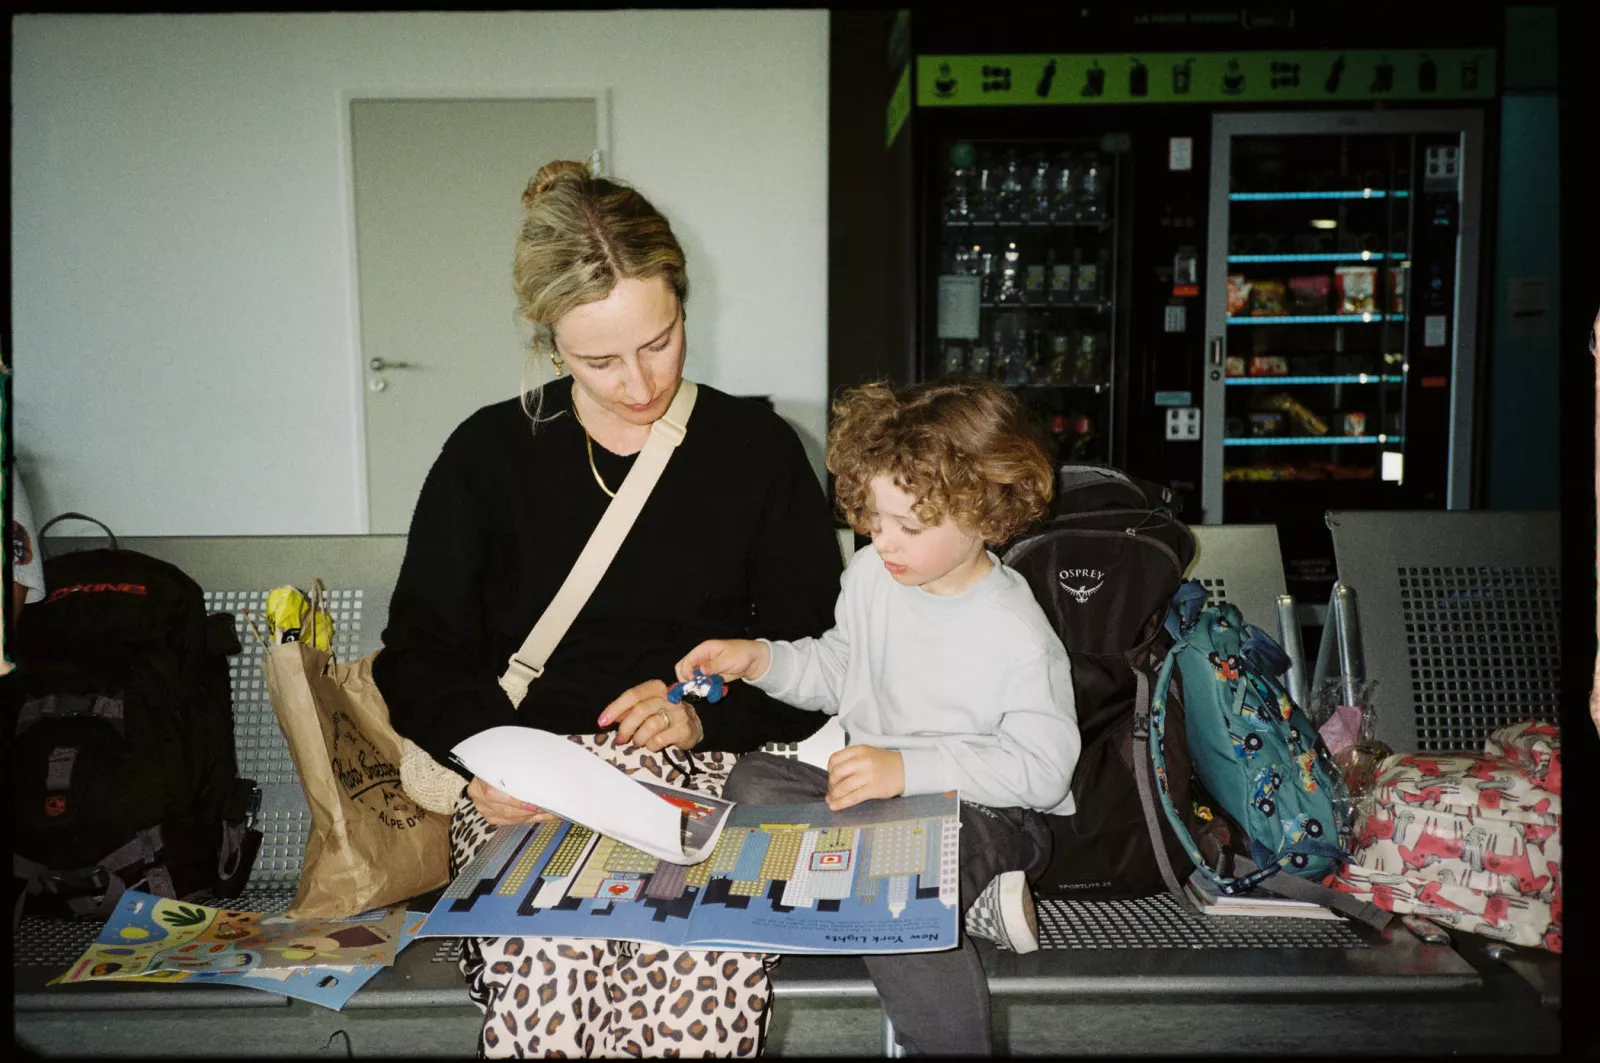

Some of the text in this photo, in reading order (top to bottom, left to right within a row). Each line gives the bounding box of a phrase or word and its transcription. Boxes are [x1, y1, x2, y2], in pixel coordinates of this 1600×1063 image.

[1059, 568, 1105, 580] OSPREY
[379, 811, 404, 830] ALPE
[823, 932, 939, 944] New York Lights
